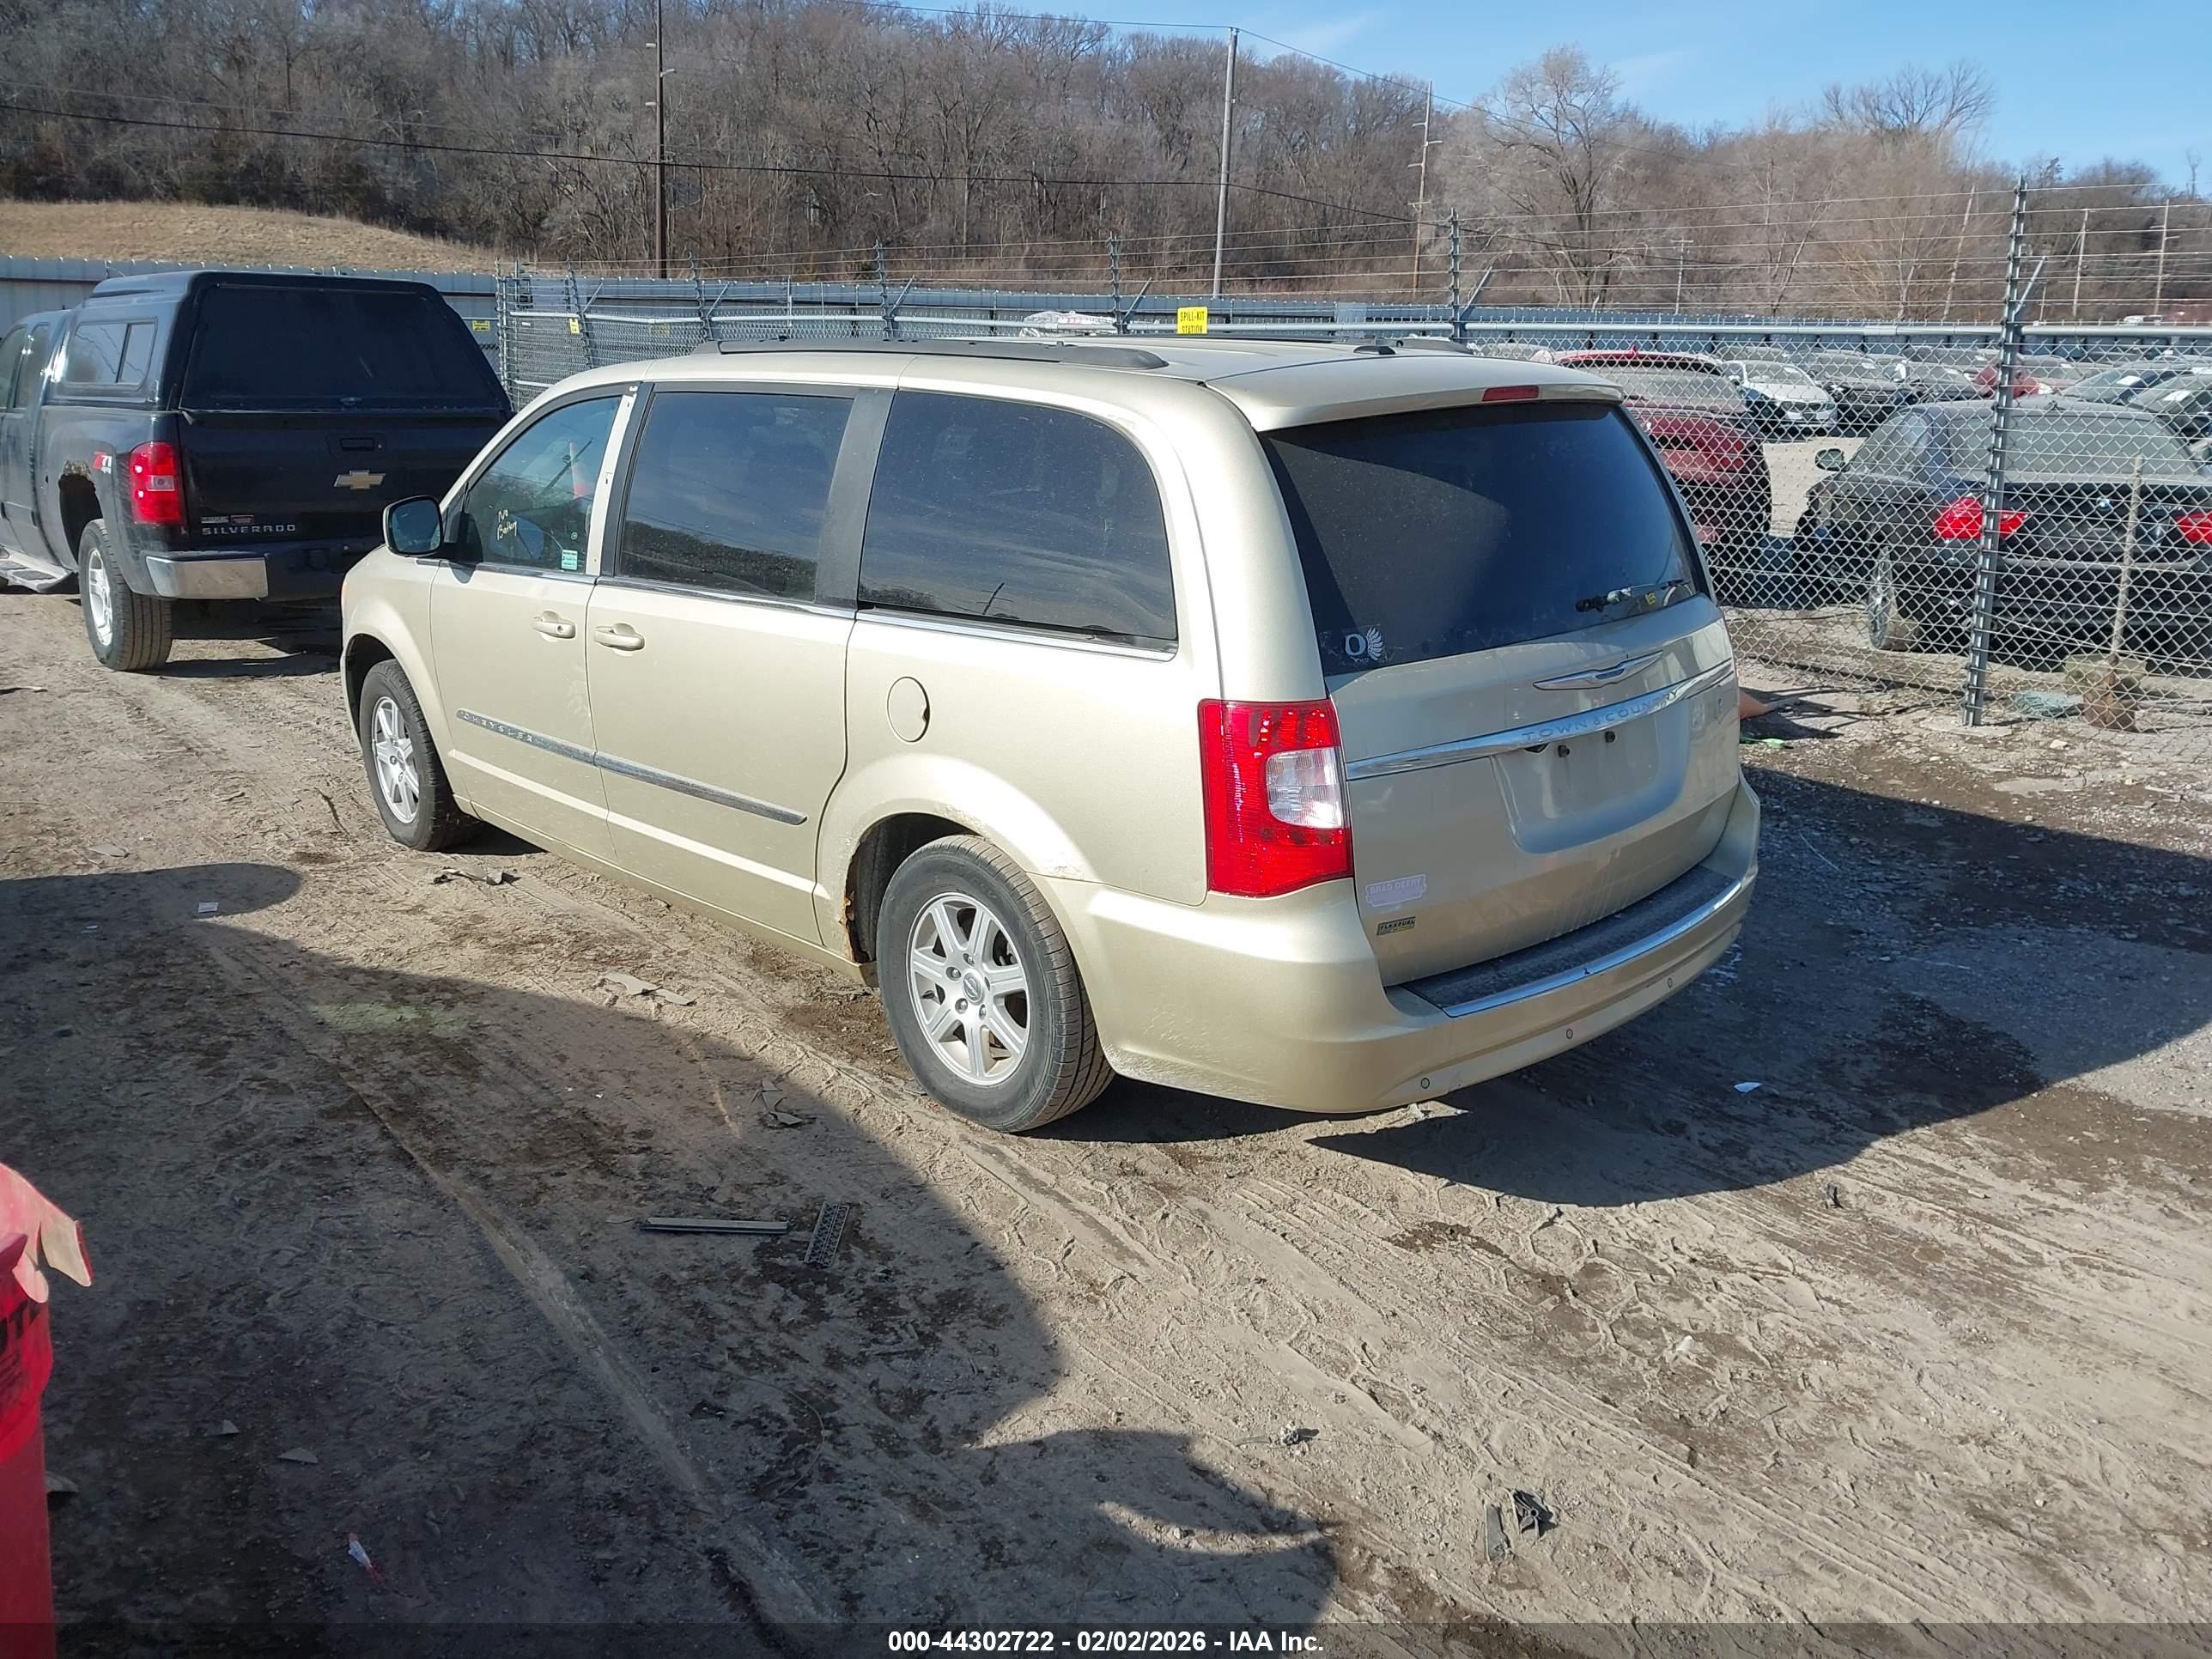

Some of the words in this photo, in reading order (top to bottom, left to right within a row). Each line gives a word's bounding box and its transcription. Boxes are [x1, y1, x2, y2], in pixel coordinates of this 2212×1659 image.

[1180, 311, 1205, 322] SPILL-KIT
[202, 524, 296, 535] SILVERADO
[1521, 720, 1588, 740] TOWN
[1605, 690, 1679, 722] COUNRY
[464, 713, 533, 742] CHRYSLER
[1370, 883, 1393, 895] BRAD
